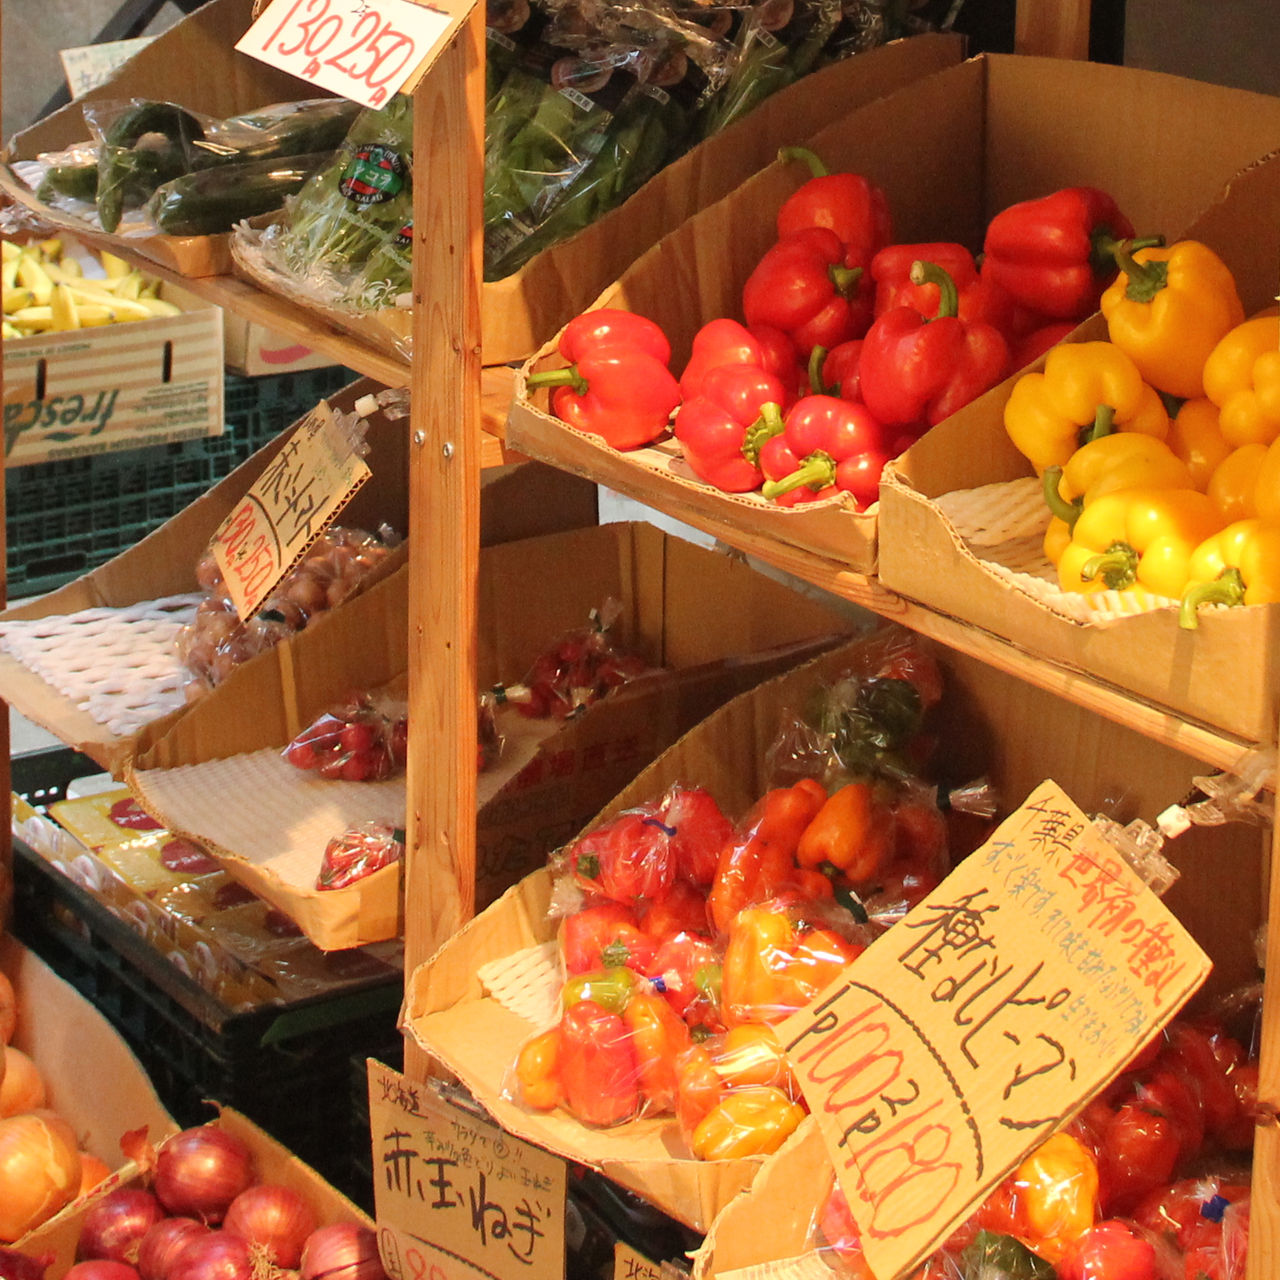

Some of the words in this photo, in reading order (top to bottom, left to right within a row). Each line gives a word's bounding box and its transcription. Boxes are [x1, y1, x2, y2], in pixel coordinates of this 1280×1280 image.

[1020, 795, 1085, 868] 千葉県
[382, 1127, 554, 1265] 赤玉ねぎ
